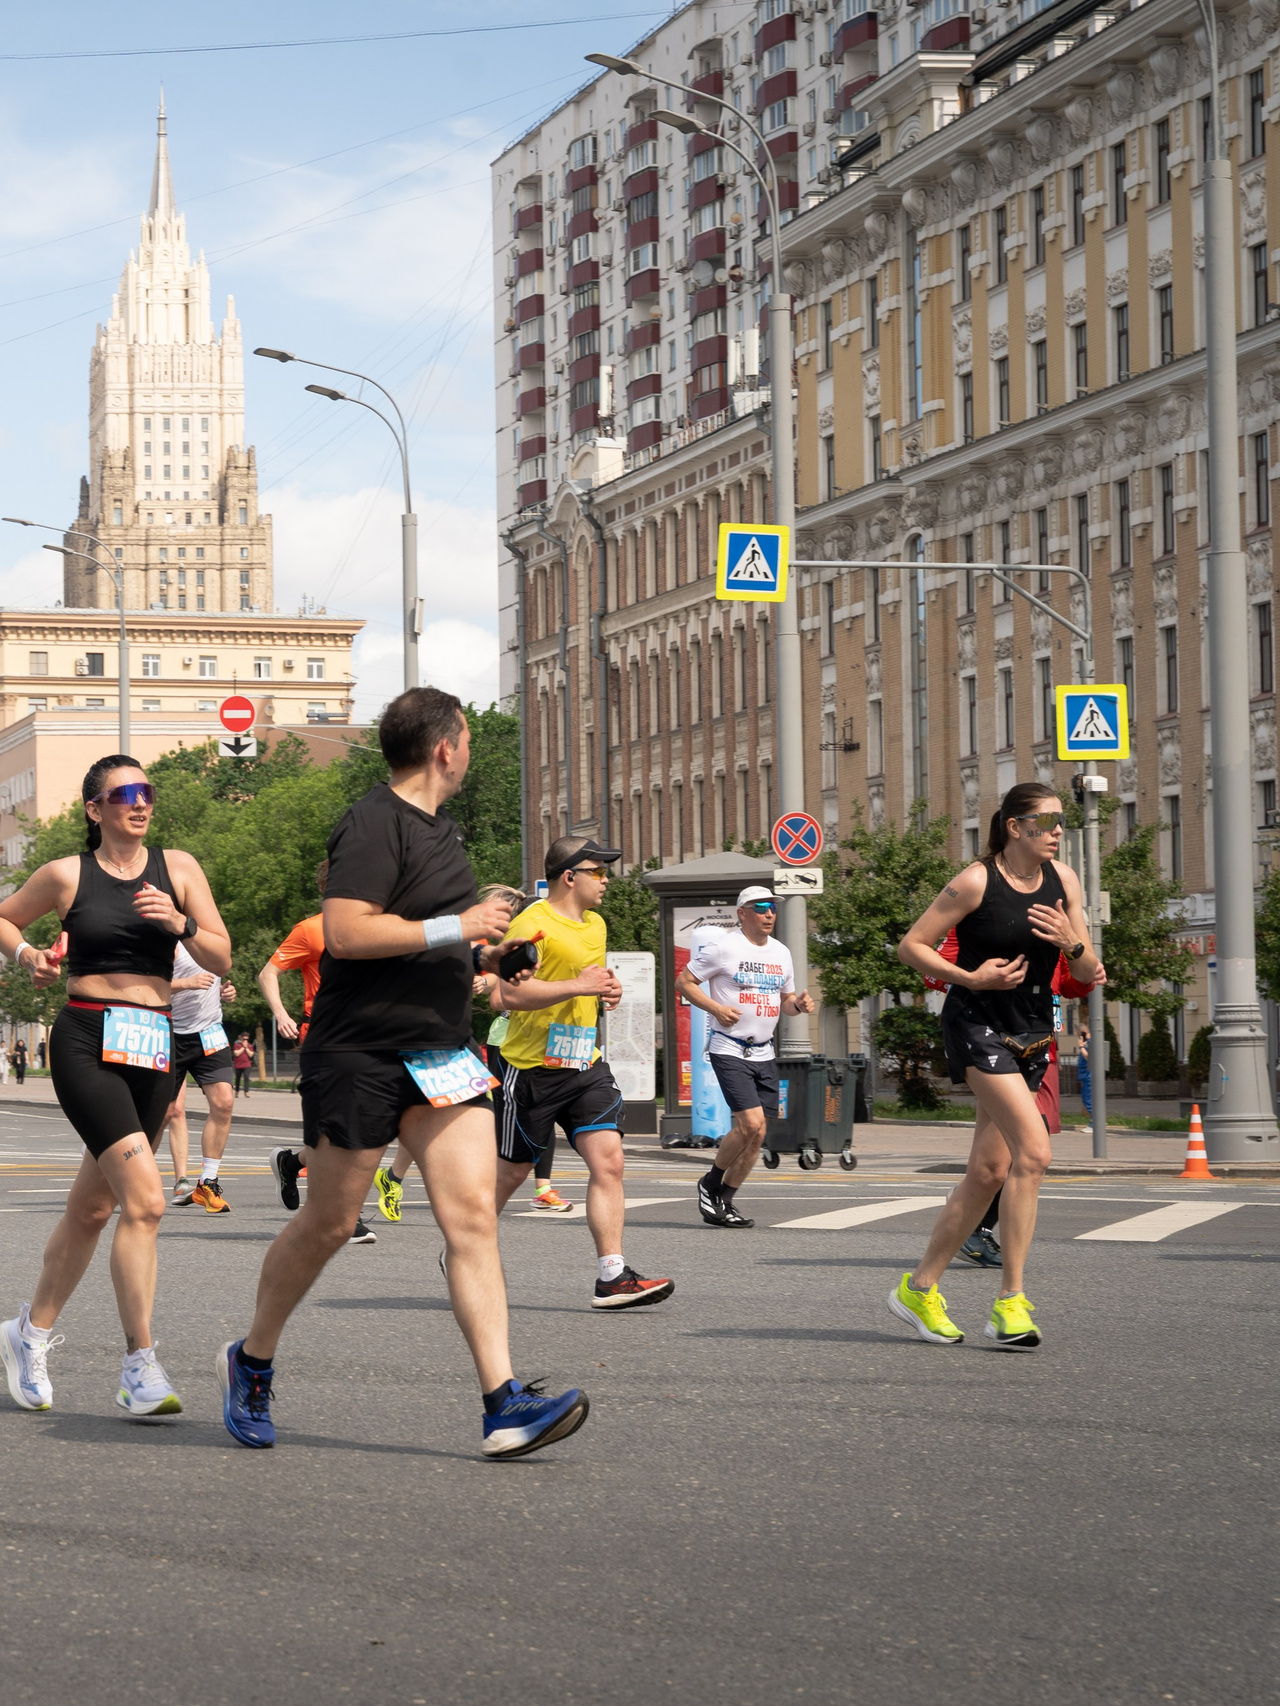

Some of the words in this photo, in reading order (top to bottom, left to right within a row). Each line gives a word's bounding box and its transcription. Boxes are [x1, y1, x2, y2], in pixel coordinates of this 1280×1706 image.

[739, 961, 783, 975] #ЗАБЕГ2025
[733, 972, 752, 984] 45%
[739, 993, 770, 1005] ВМЕСТЕ
[756, 1005, 762, 1016] С
[115, 1022, 165, 1056] 75711
[553, 1035, 592, 1059] 75103
[156, 1053, 166, 1069] C
[581, 1062, 589, 1071] D
[415, 1057, 483, 1095] 72537
[470, 1078, 488, 1092] C
